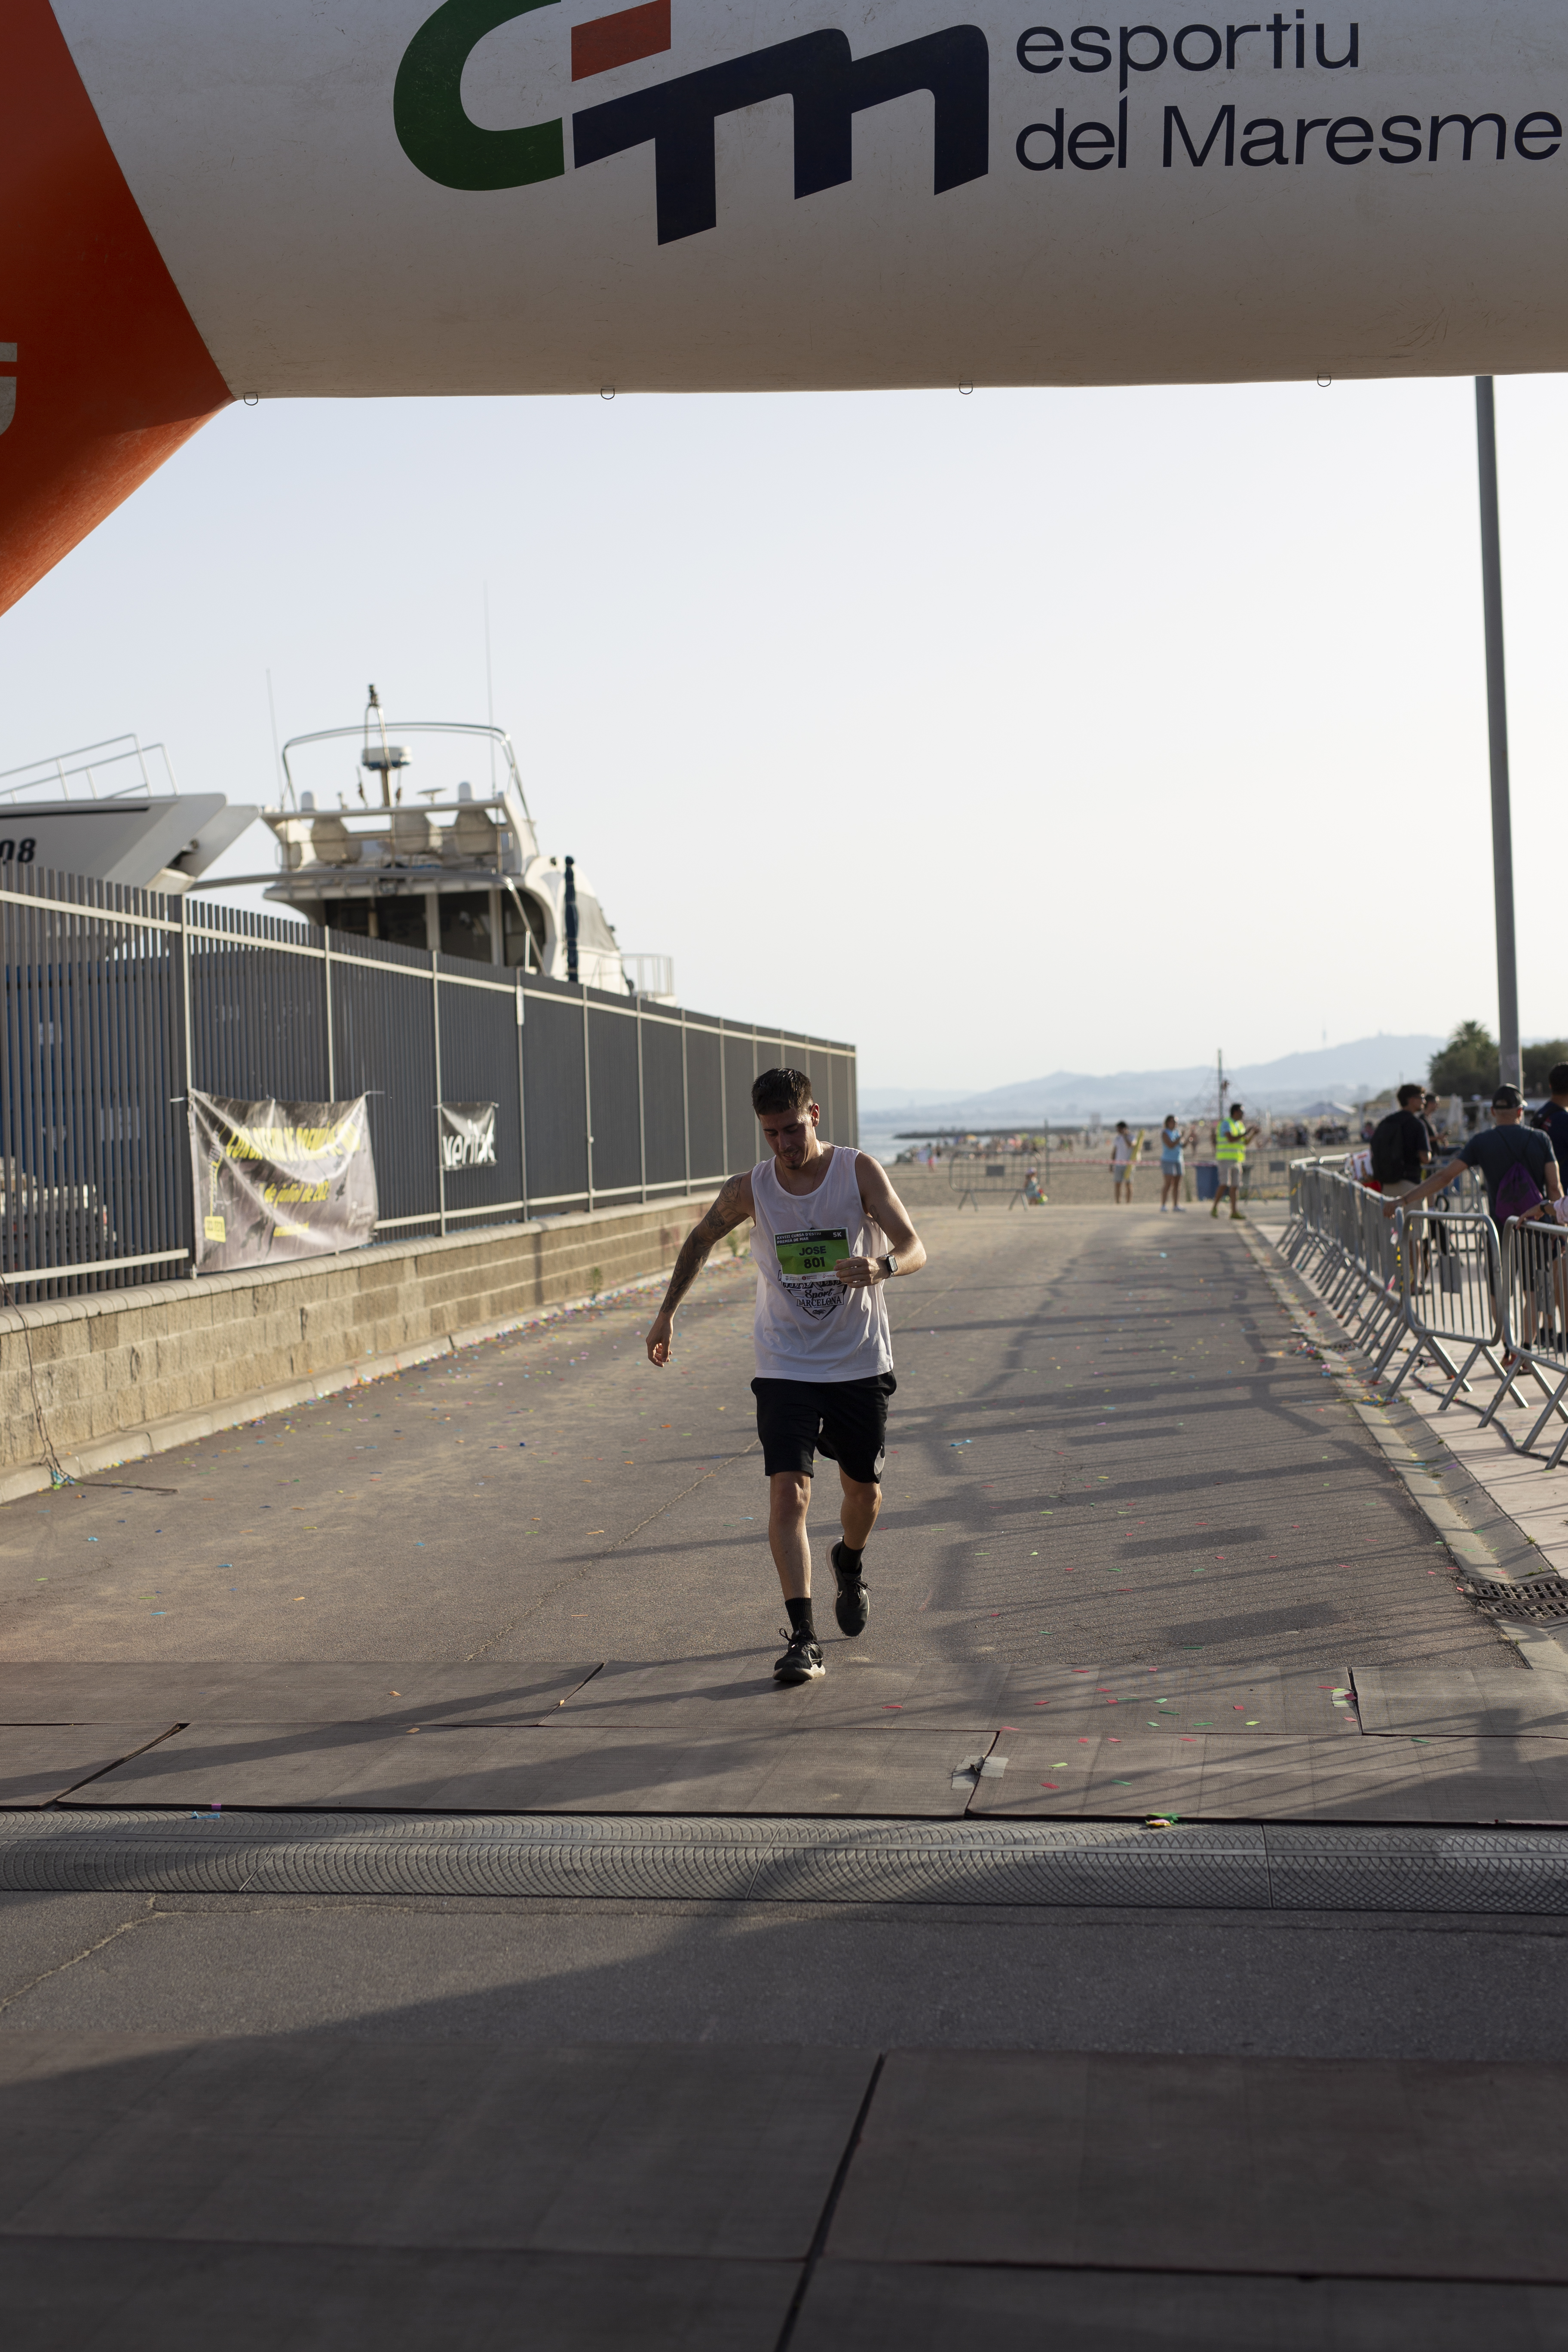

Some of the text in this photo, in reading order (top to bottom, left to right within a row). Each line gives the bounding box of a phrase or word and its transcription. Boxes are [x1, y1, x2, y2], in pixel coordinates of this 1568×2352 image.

[1016, 9, 1359, 94] esportiu
[1016, 95, 1562, 171] del Maresme
[799, 1246, 827, 1256] JOSE
[804, 1256, 825, 1269] 801
[805, 1288, 835, 1301] Sport
